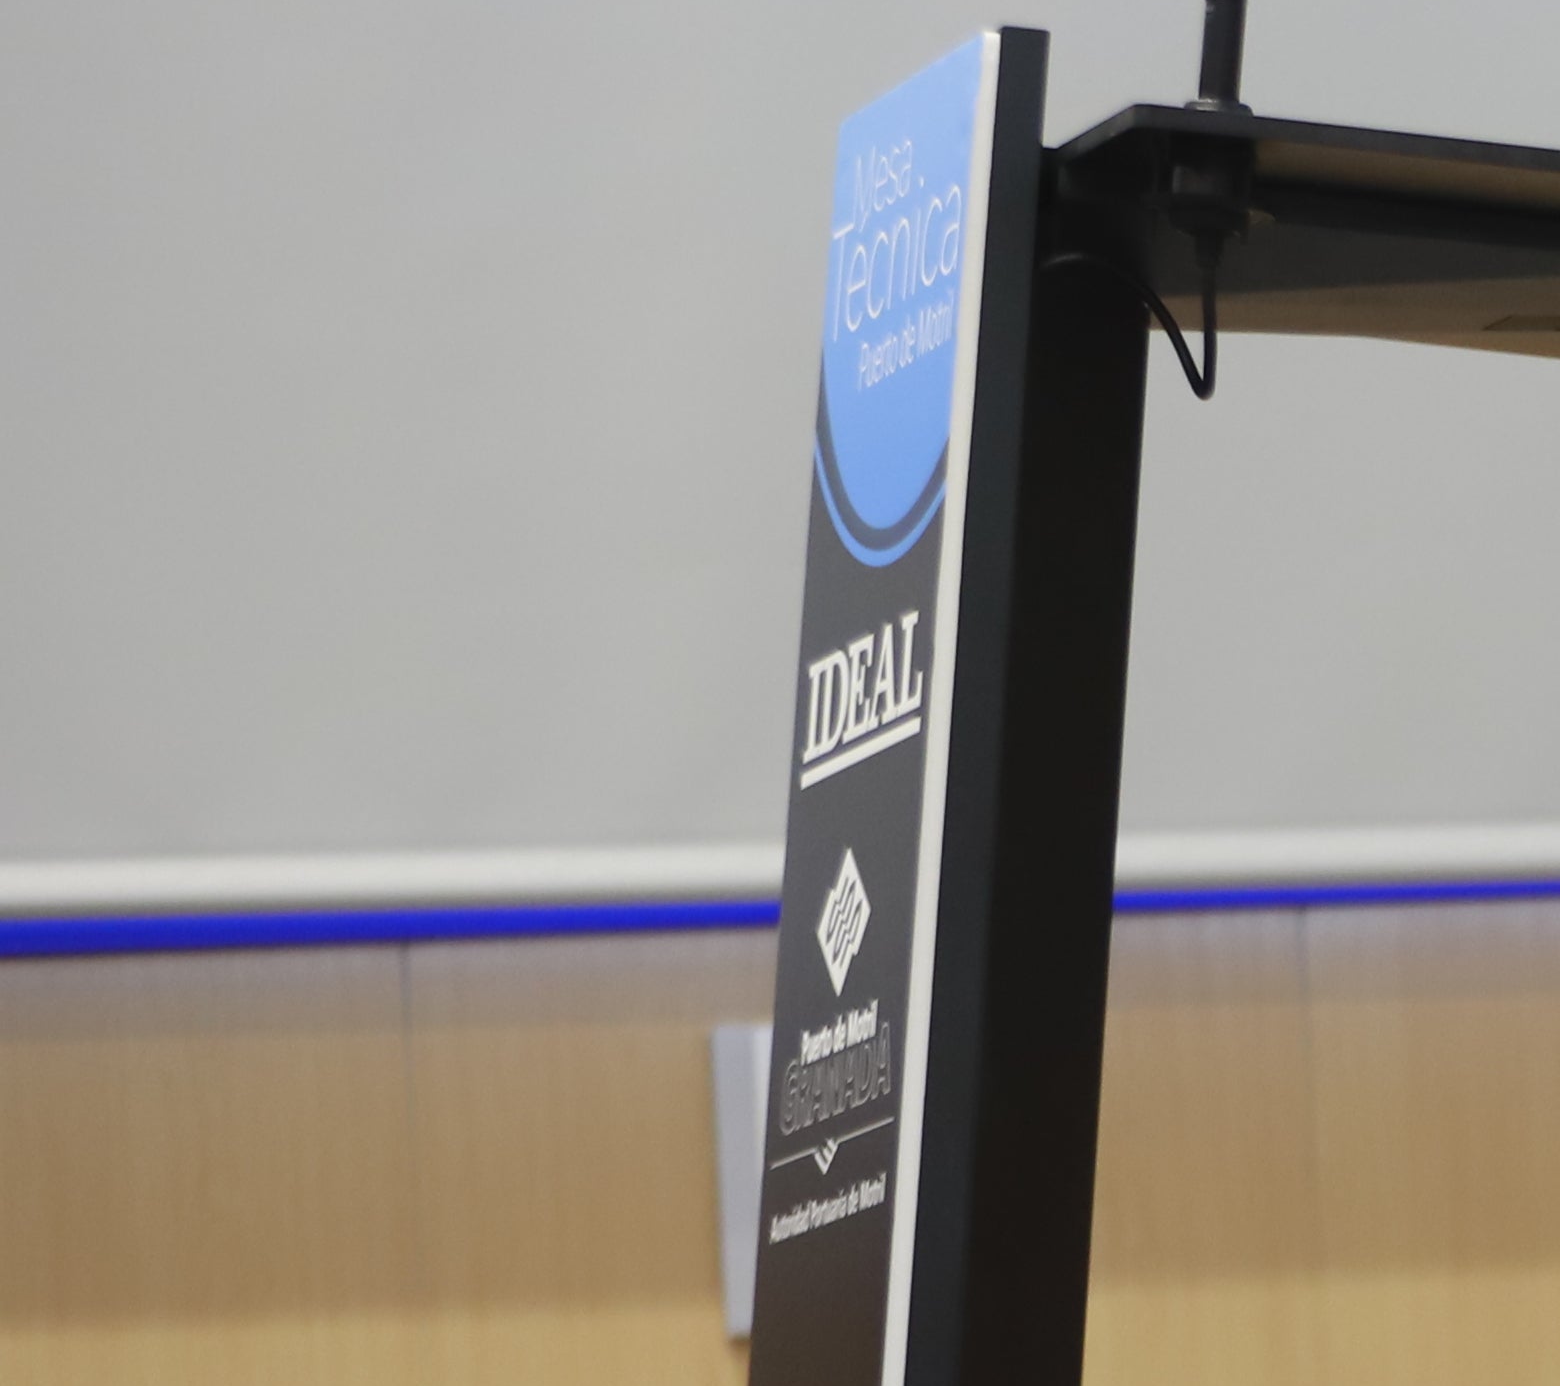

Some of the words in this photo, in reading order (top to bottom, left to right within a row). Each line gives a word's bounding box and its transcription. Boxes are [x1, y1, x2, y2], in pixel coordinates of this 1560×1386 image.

[853, 138, 913, 224] Mesa
[858, 332, 898, 393] Puerto
[899, 314, 916, 368] de
[917, 288, 955, 358] Motril
[803, 611, 923, 764] IDEAL
[779, 1021, 892, 1136] GRANADA
[800, 1025, 833, 1067] Puerto
[833, 1015, 846, 1054] de
[846, 998, 879, 1049] Motril
[769, 1200, 810, 1246] Autoridad
[810, 1188, 847, 1230] Portuaria
[848, 1183, 859, 1218] de
[860, 1170, 887, 1212] Motril
